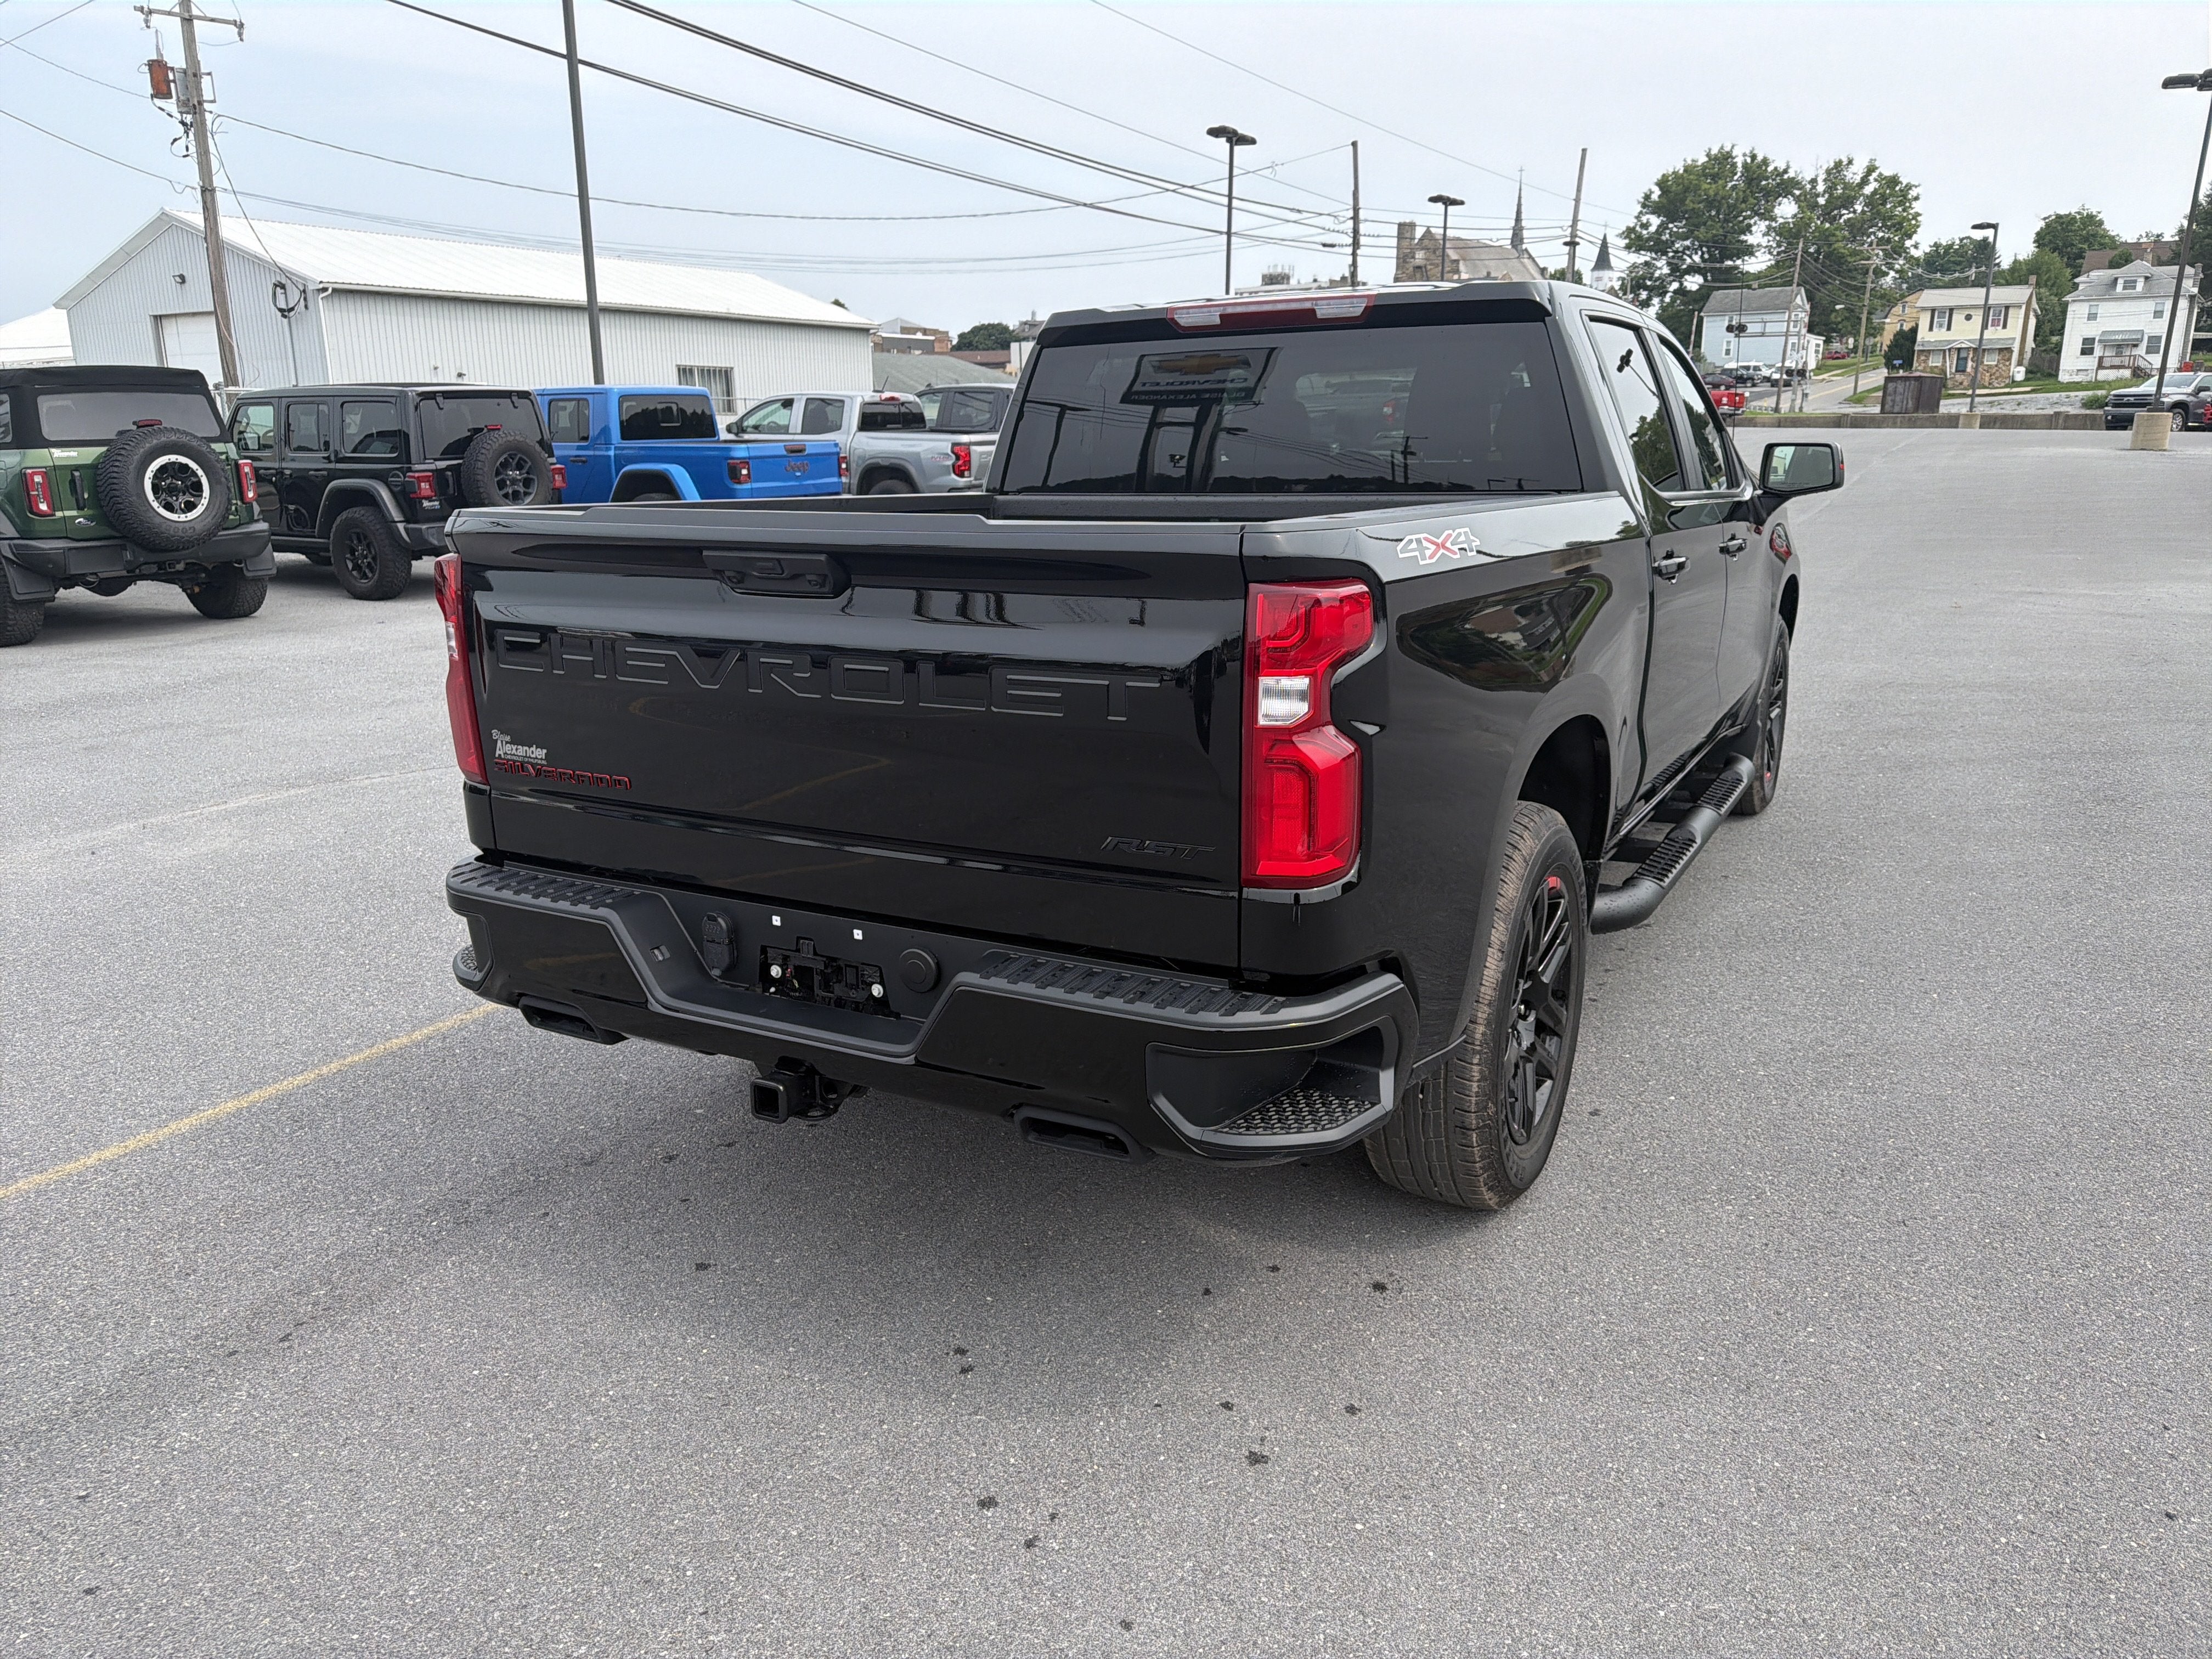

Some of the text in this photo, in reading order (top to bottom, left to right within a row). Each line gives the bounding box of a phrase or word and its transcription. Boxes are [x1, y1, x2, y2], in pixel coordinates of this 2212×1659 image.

[785, 459, 809, 473] Jeep
[494, 629, 1162, 721] CHEVROLET
[492, 729, 511, 742] Blaise
[495, 740, 547, 759] Alexander
[494, 759, 631, 790] SILVERADO
[1101, 836, 1216, 860] RST
